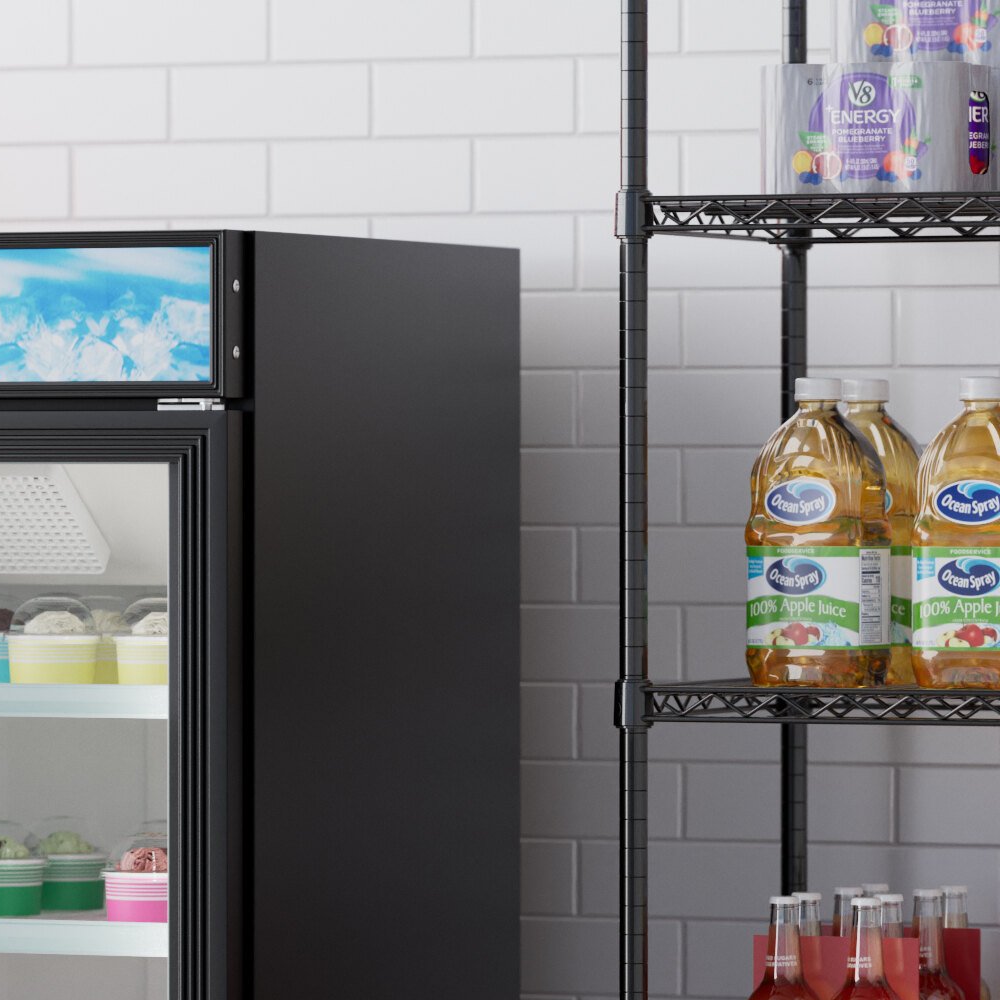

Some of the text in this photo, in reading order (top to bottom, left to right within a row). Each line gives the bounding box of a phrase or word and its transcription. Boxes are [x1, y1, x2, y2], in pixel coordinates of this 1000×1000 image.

[908, 7, 956, 16] BLUEBERRY
[849, 80, 873, 104] V8
[832, 127, 893, 136] POMEGRANATE
[838, 135, 886, 143] BLUEBERRY
[771, 493, 826, 516] Ocean Spray
[941, 493, 1000, 517] Ocean Spray
[769, 568, 819, 590] Ocean Spray
[941, 569, 996, 591] Ocean Spray
[750, 597, 847, 618] 100% Apple Juice
[920, 600, 950, 618] 100%
[953, 597, 992, 618] Apple
